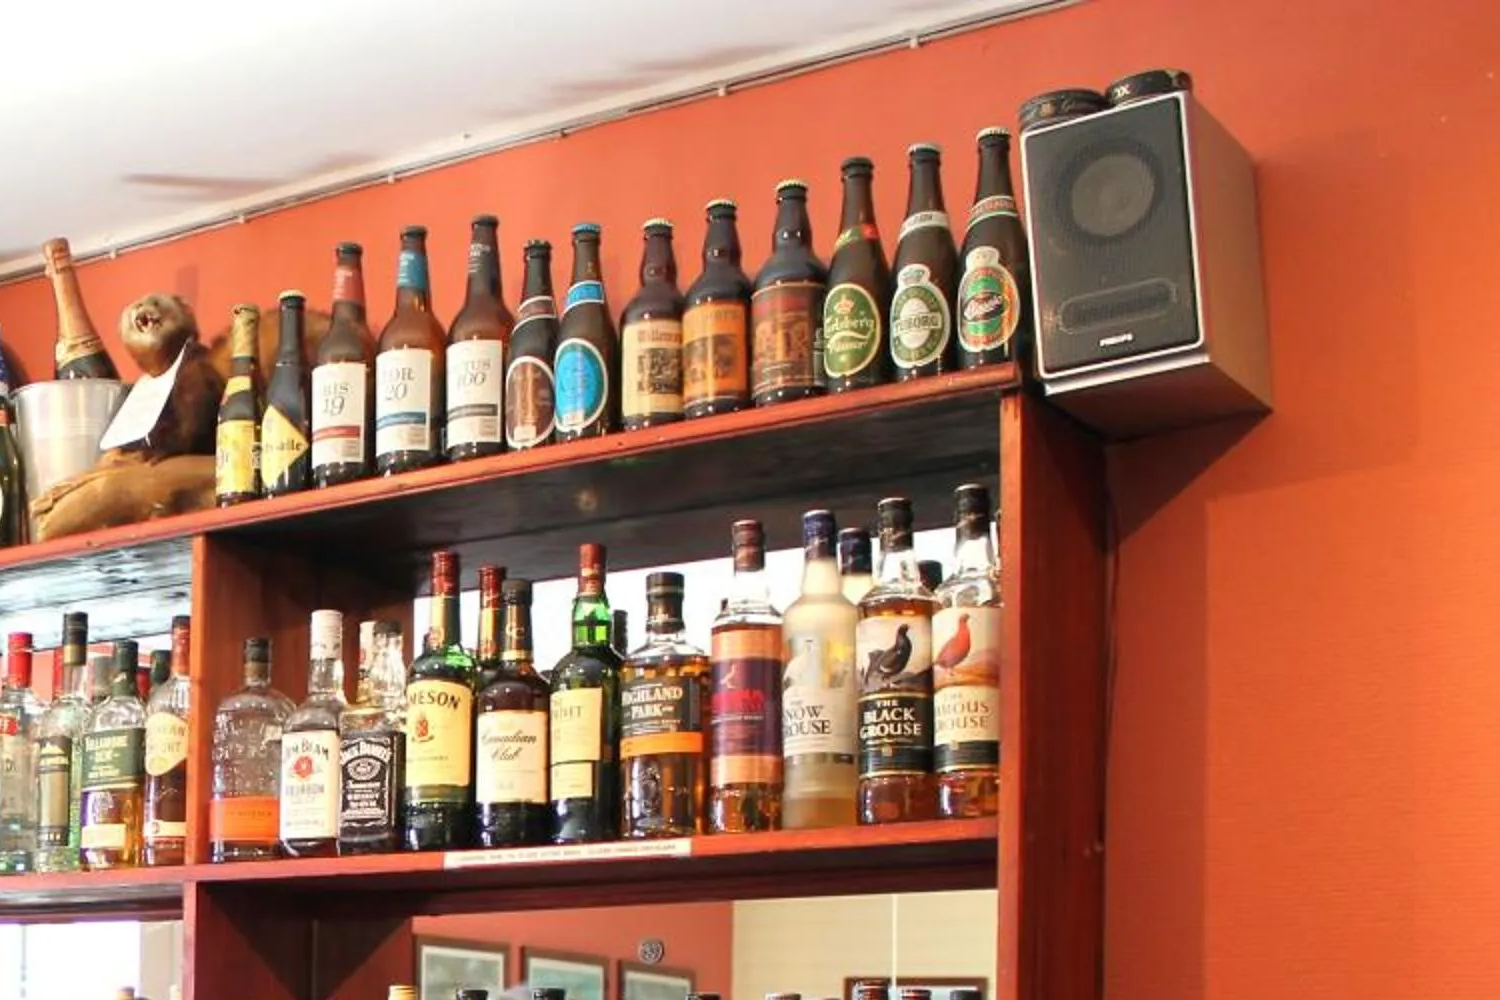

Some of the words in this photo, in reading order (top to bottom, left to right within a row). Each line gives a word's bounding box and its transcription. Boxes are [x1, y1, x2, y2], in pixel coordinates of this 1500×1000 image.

[632, 703, 663, 719] PARK
[877, 699, 899, 707] THE
[786, 705, 825, 721] NOW
[864, 707, 916, 724] BLACK
[860, 723, 922, 739] GROUSE
